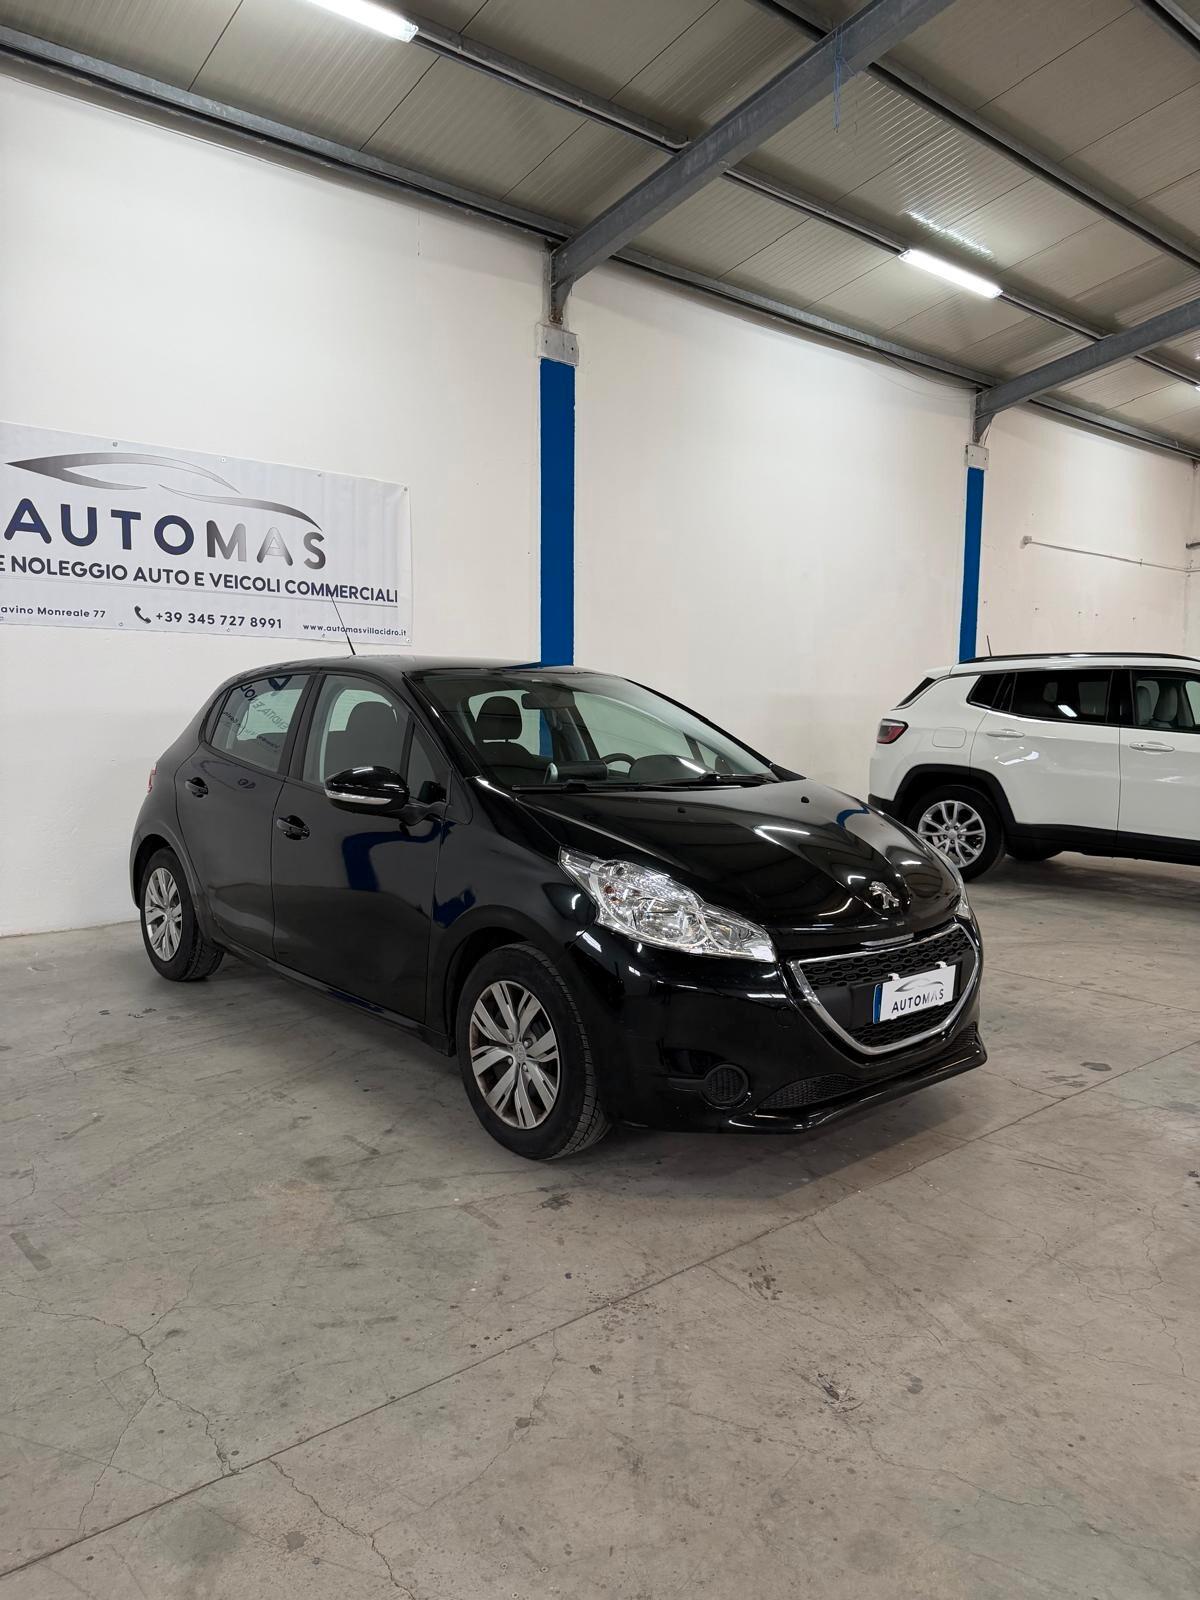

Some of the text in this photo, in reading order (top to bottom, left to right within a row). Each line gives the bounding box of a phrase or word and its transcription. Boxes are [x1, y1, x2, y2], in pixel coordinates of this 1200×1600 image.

[3, 497, 326, 569] AUTOMAS
[11, 555, 128, 581] NOLEGGIO
[132, 566, 190, 586] AUTO
[194, 571, 205, 587] E
[209, 572, 280, 593] VEICOLI
[284, 579, 398, 603] COMMERCIALI
[37, 606, 90, 618] Monreale
[93, 609, 106, 618] 77
[156, 611, 282, 629] +39 345 727 8991
[302, 623, 407, 637] www.automasvillacidro.it
[891, 988, 944, 1014] AUTOMAS
